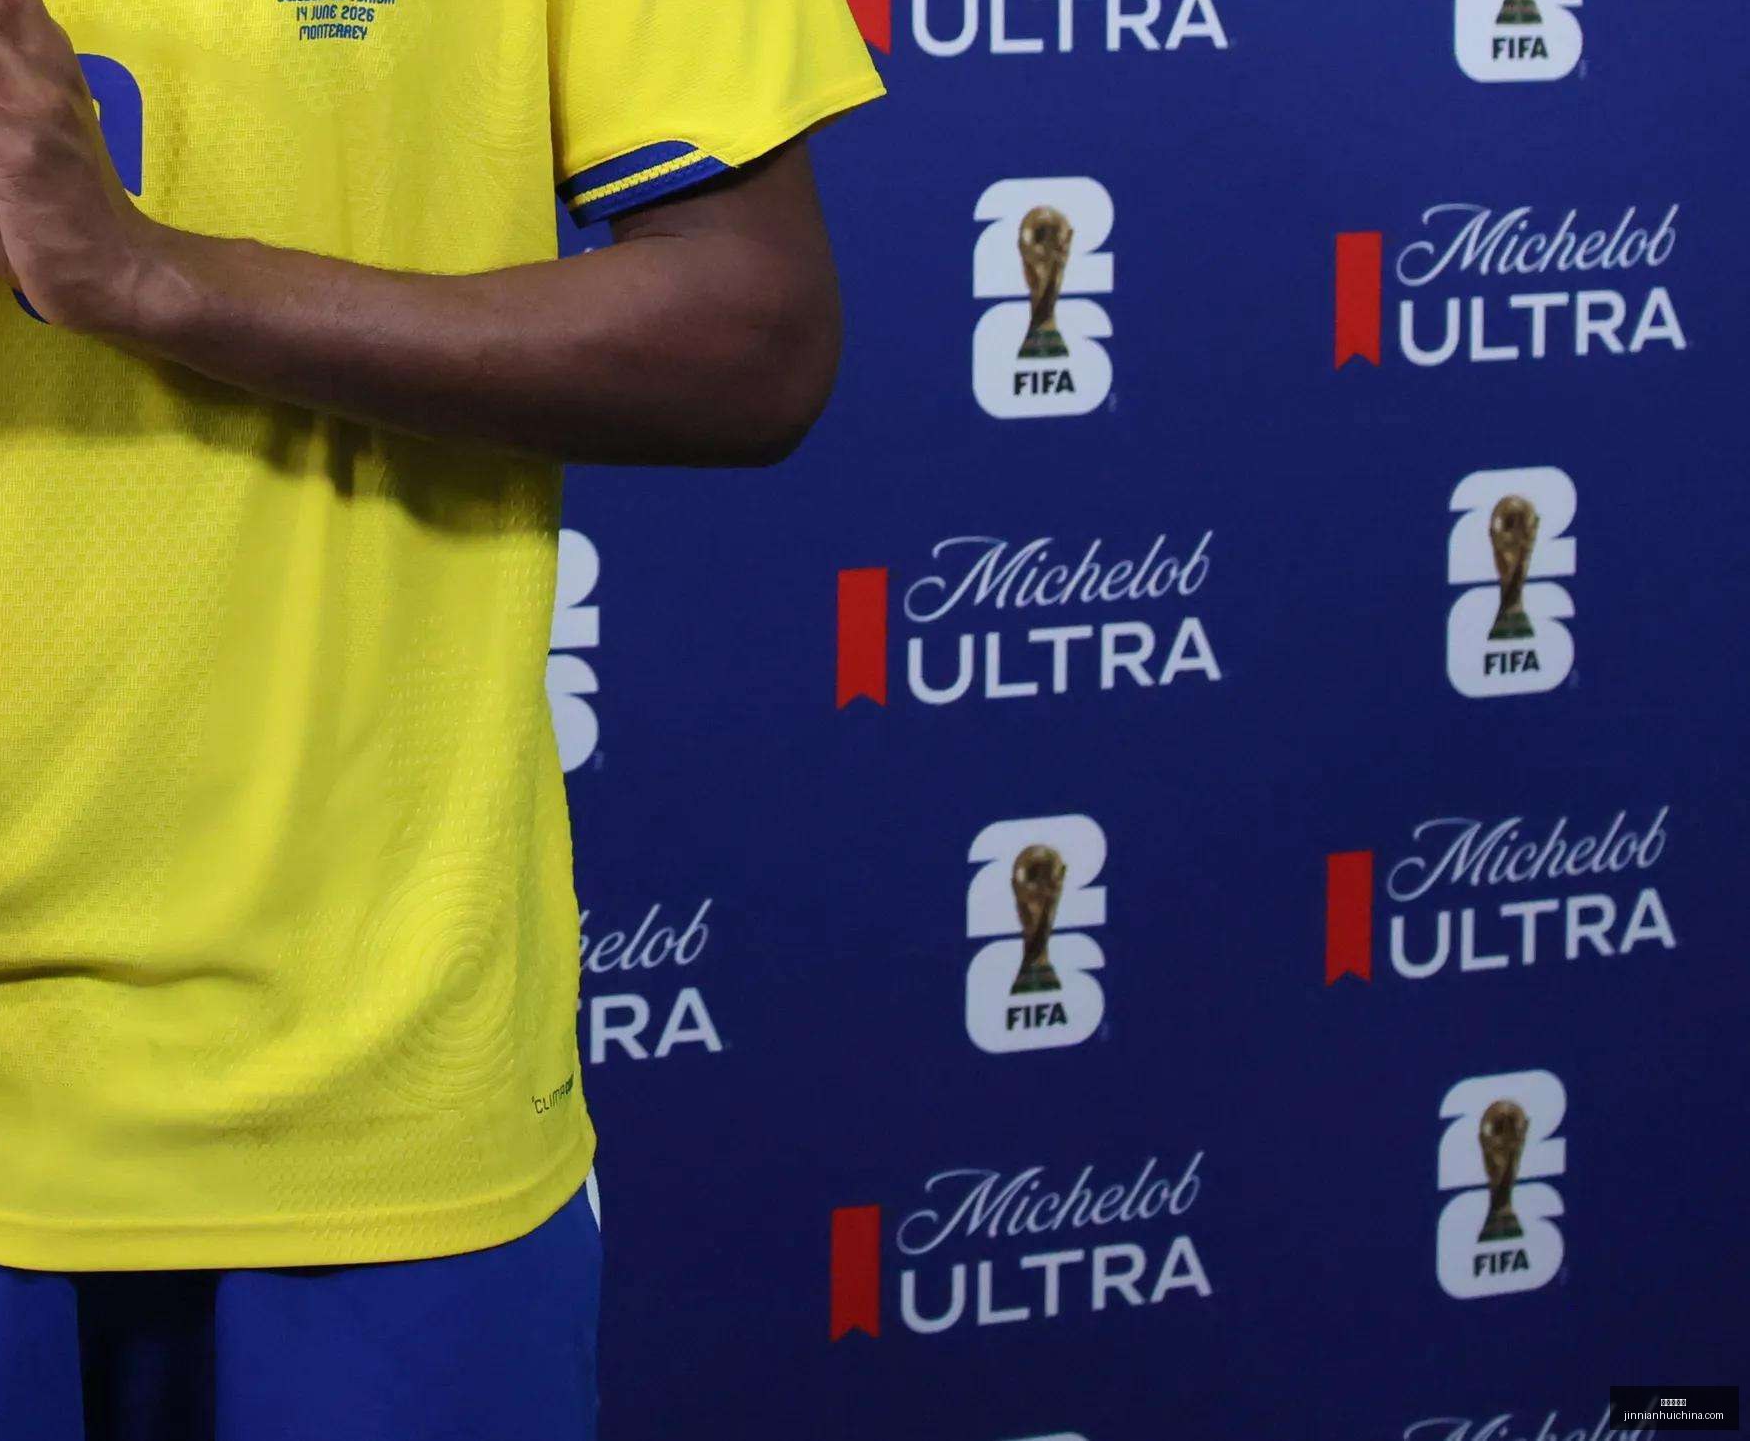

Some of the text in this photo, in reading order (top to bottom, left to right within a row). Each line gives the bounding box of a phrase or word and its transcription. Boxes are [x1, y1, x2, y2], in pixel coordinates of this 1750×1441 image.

[296, 4, 375, 23] 14 JUNE 2026
[299, 23, 368, 41] MONTERREY
[1493, 37, 1548, 59] FIFA
[1397, 203, 1678, 286] Michelob
[1399, 287, 1686, 366] ULTRA
[1014, 370, 1074, 395] FIFA
[904, 530, 1212, 622] Michelob
[908, 617, 1222, 705] ULTRA
[1484, 650, 1539, 675] FIFA
[1388, 806, 1668, 901] Michelob
[1390, 888, 1676, 978] ULTRA
[1006, 1003, 1067, 1030] FIFA
[897, 1152, 1204, 1254] Michelob
[901, 1236, 1212, 1333] ULTRA
[1474, 1249, 1529, 1277] FIFA
